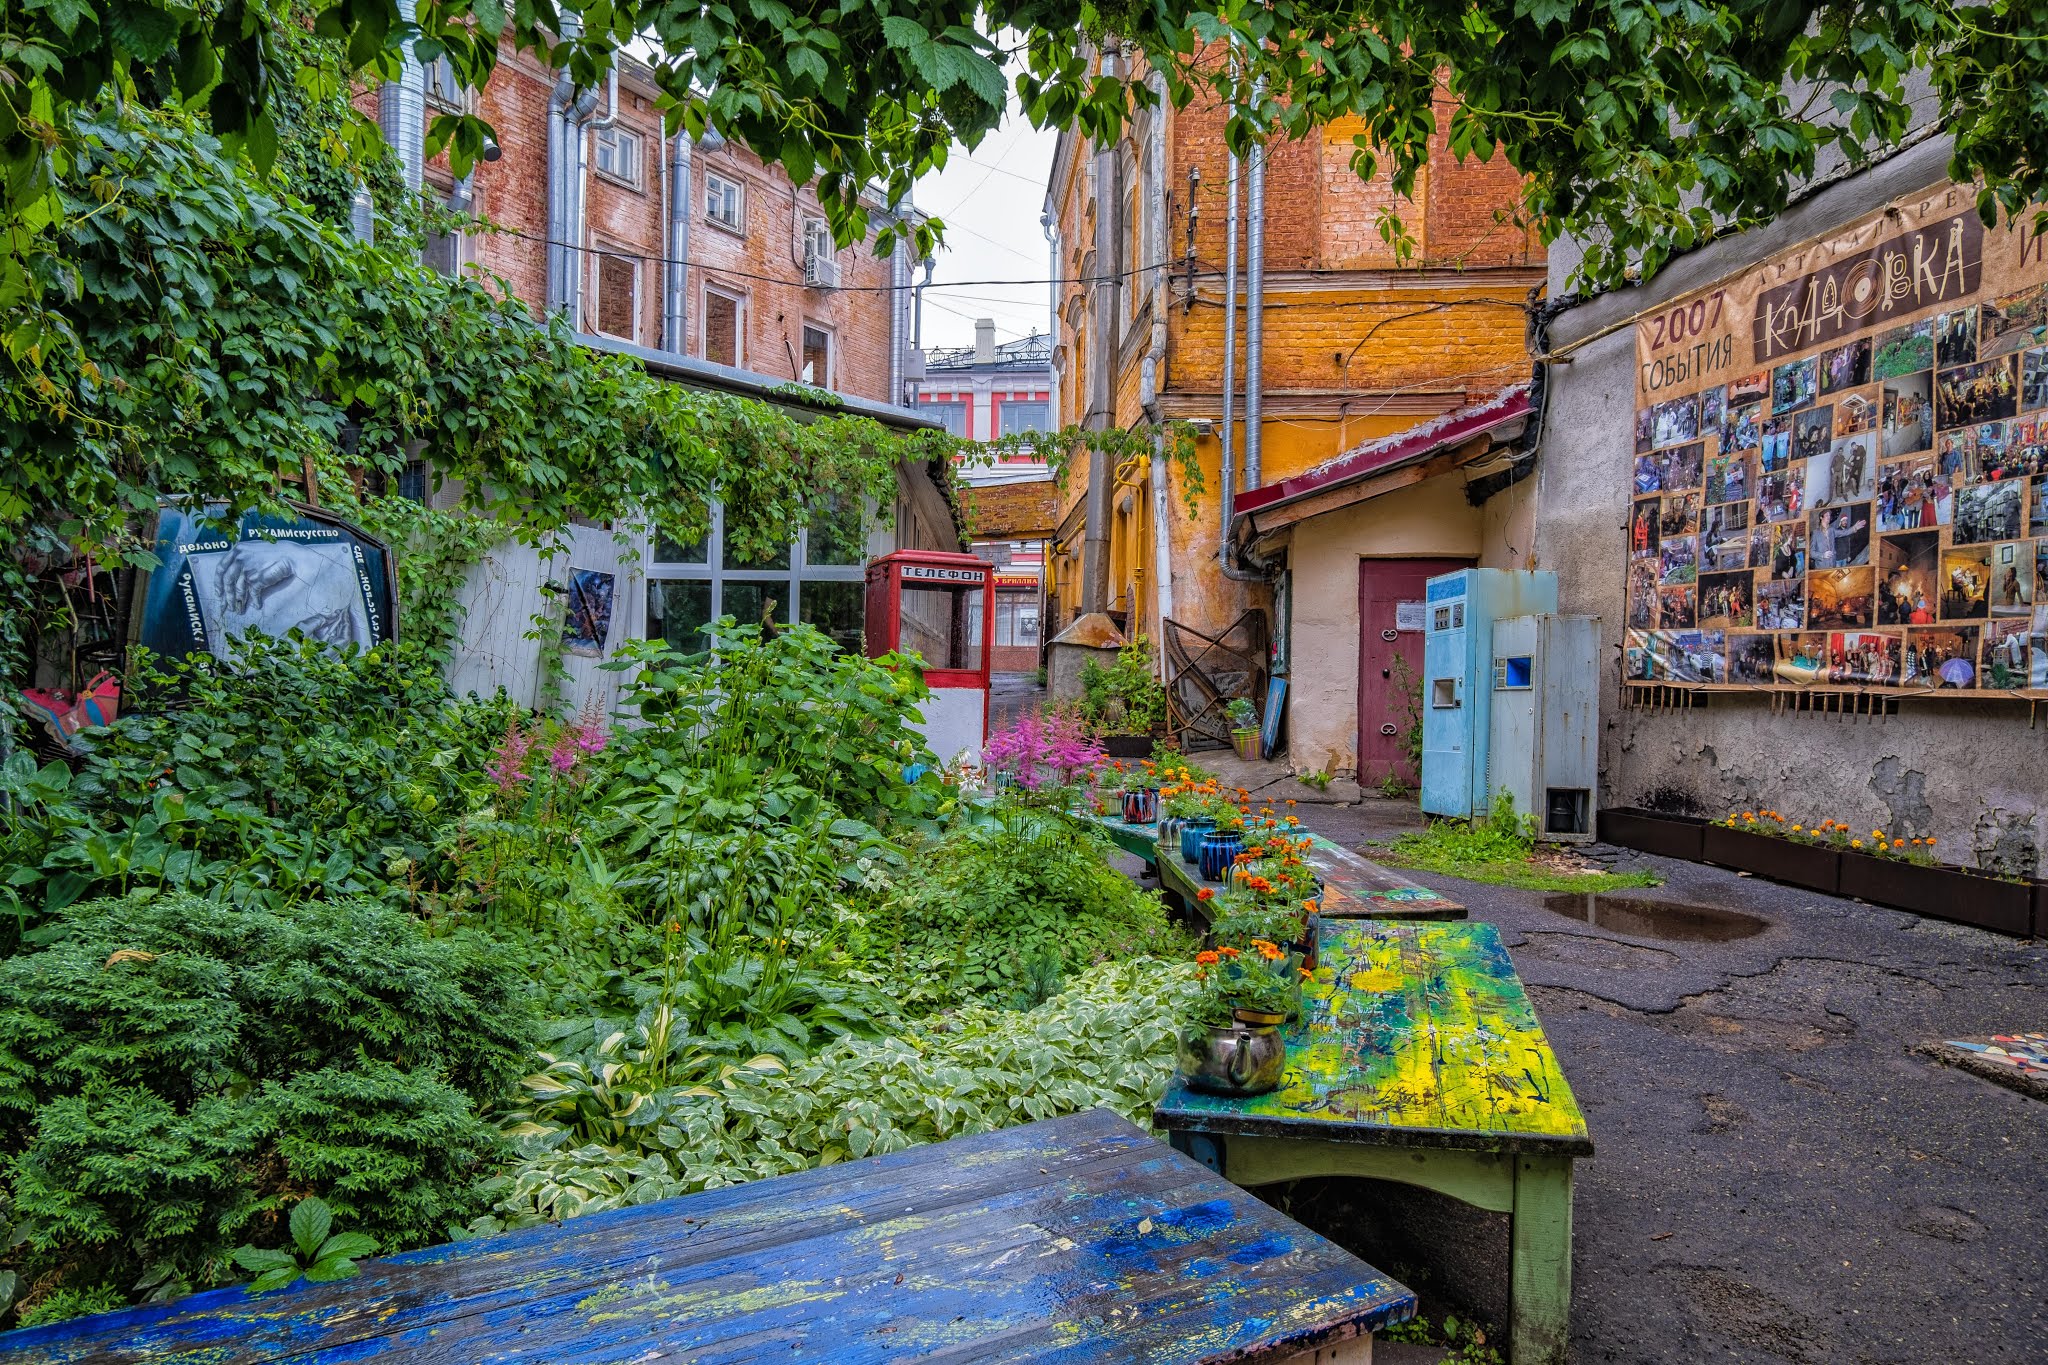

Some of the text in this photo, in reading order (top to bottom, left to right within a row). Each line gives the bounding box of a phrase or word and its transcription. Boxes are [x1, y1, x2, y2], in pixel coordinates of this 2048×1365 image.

[1765, 217, 1965, 357] КЛАДОВКА
[1651, 289, 1726, 351] 2007
[1641, 333, 1732, 393] СОБЫТИЯ
[903, 566, 983, 581] ТЕЛЕФОН
